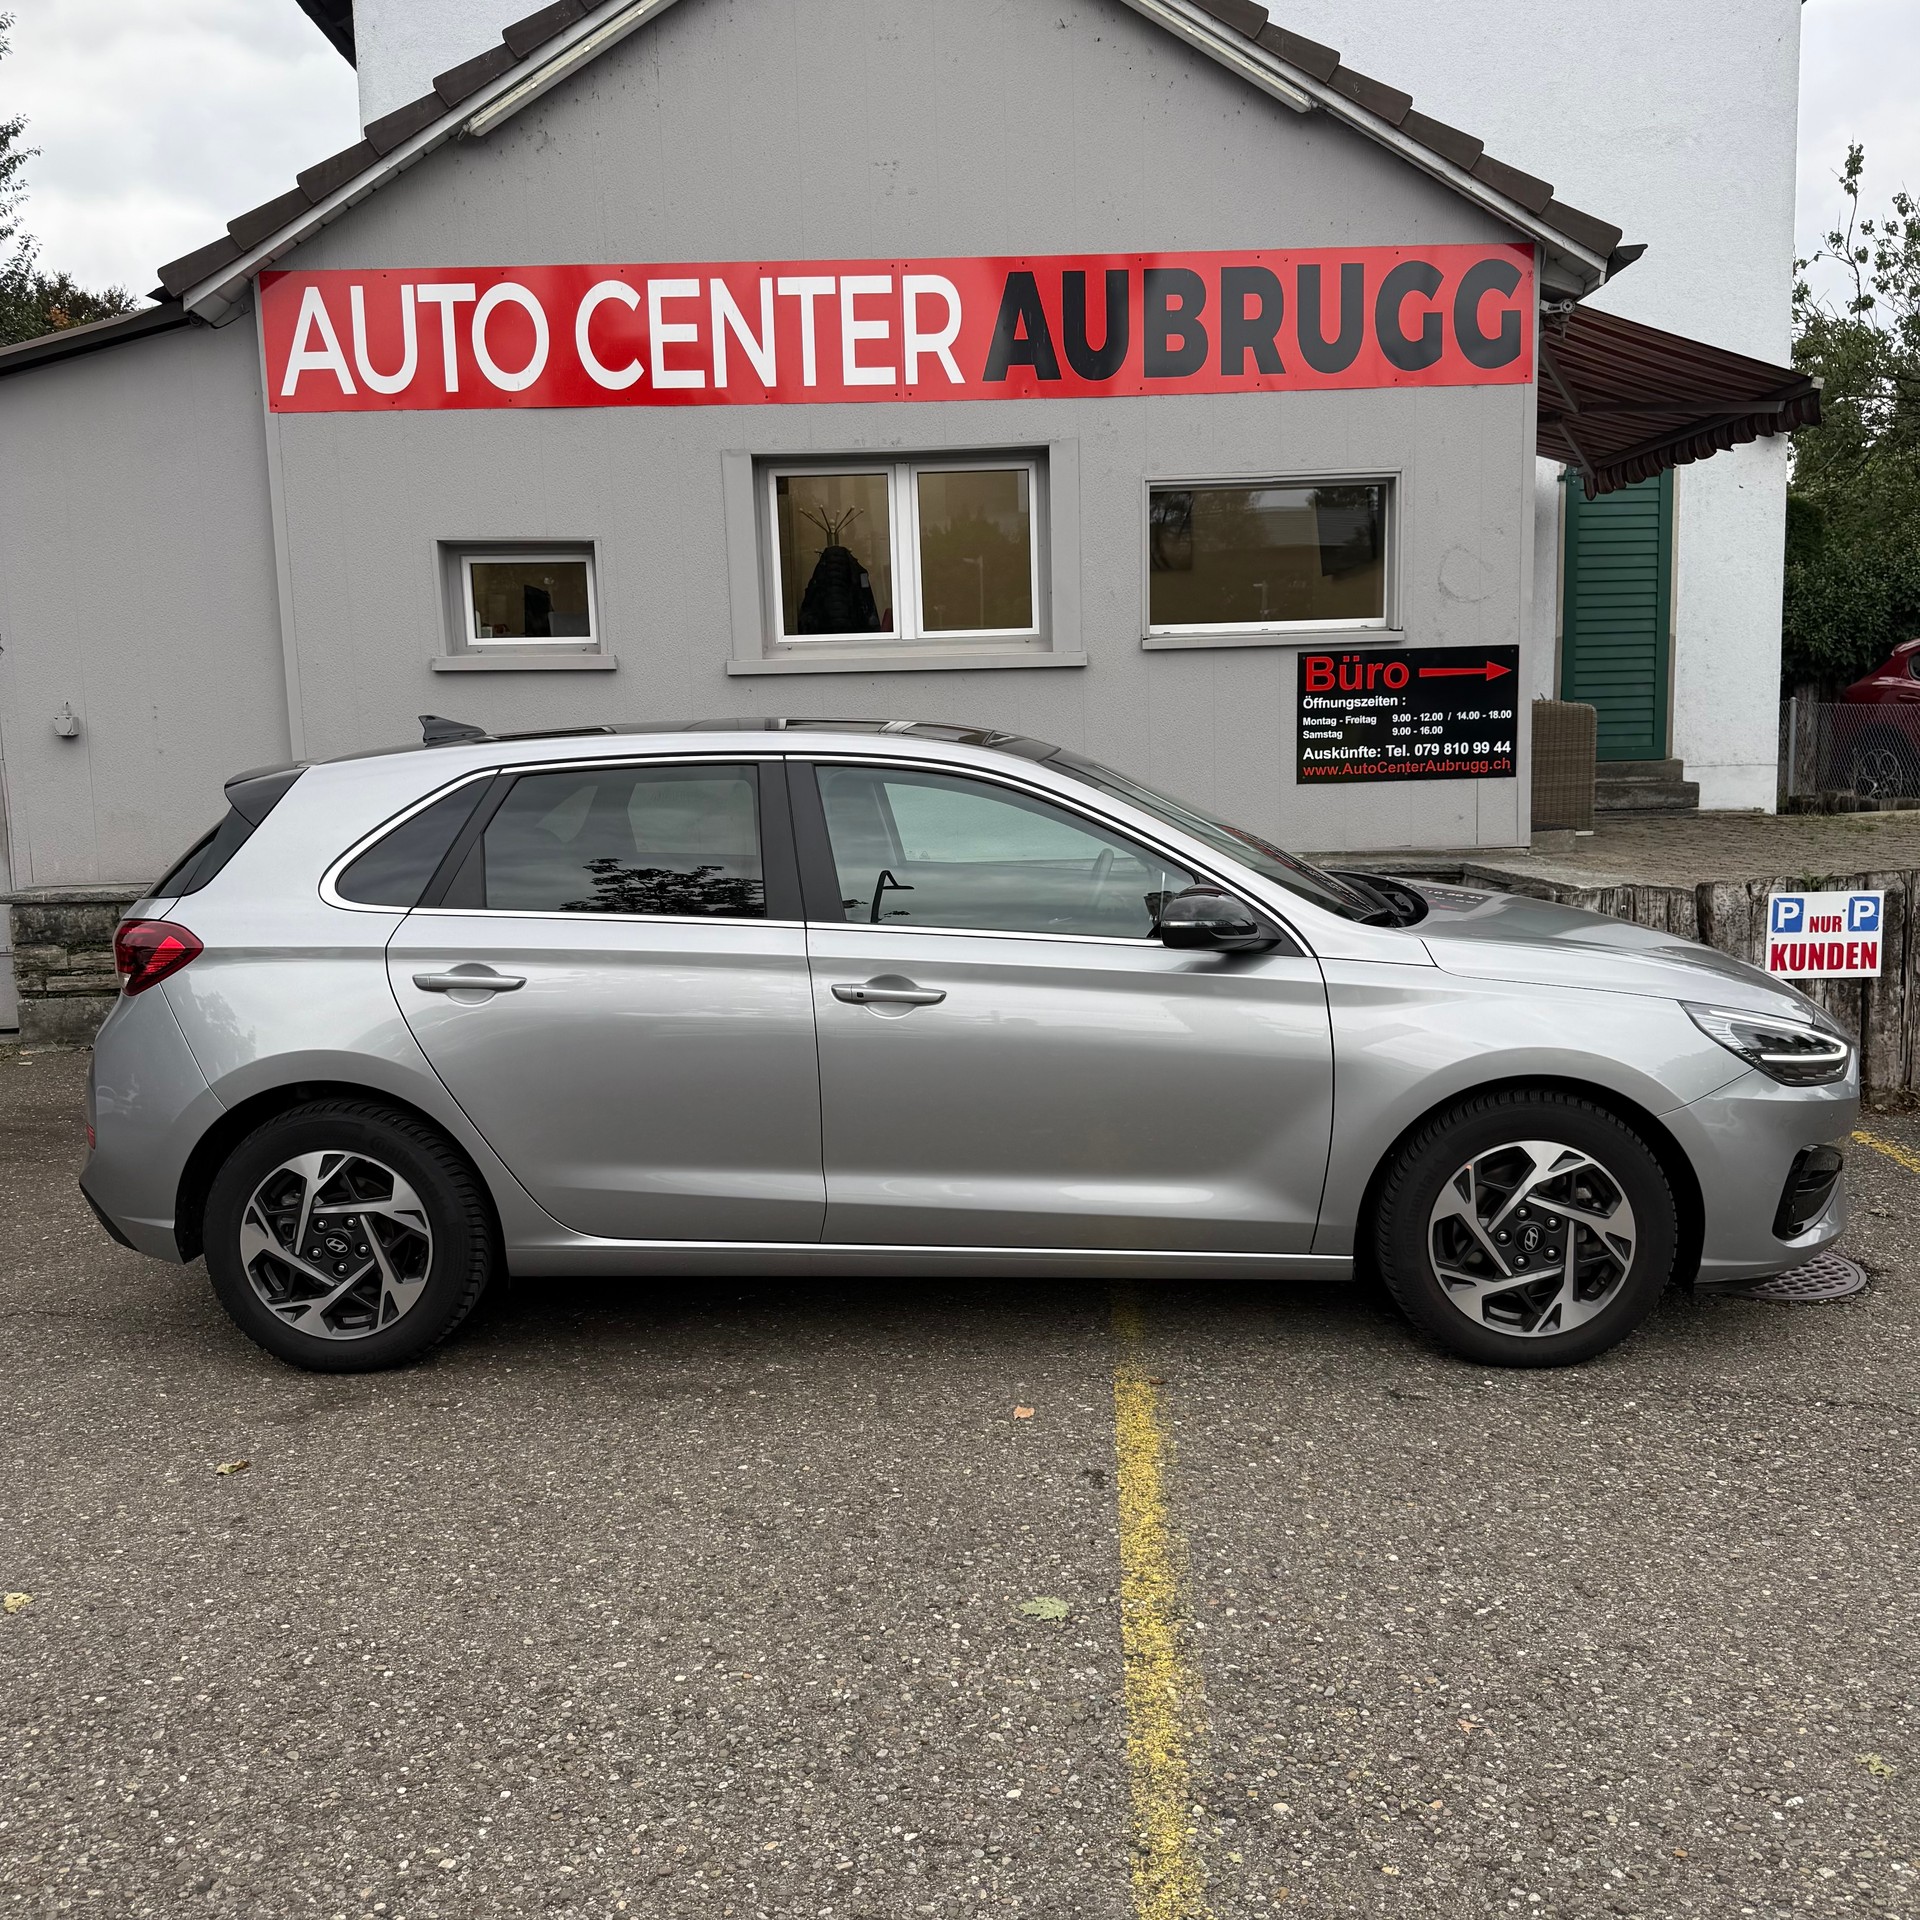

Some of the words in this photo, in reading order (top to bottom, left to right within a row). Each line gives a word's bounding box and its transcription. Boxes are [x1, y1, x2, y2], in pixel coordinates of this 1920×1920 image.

[280, 282, 551, 396] AUTO
[574, 273, 966, 391] CENTER
[982, 258, 1524, 382] AUBRUGG
[1305, 655, 1410, 692] Büro
[1302, 695, 1399, 711] Öffnungszeiten
[1302, 716, 1337, 727] Montag
[1345, 714, 1377, 726] Freitag
[1391, 713, 1412, 723] 9.00
[1419, 711, 1444, 722] 12.00
[1456, 710, 1481, 721] 14.00
[1488, 709, 1513, 720] 18.00
[1302, 730, 1343, 741] Samstag
[1391, 726, 1412, 736] 9.00
[1419, 725, 1444, 735] 16.00
[1302, 745, 1382, 761] Auskünfte:
[1385, 744, 1411, 758] Tel.
[1414, 742, 1440, 757] 079
[1443, 741, 1470, 756] 810
[1472, 741, 1491, 755] 99
[1493, 740, 1512, 754] 44
[1302, 757, 1511, 776] www.AutoCenterAubrugg.ch
[1777, 901, 1800, 929] P
[1809, 915, 1843, 933] NUR
[1853, 900, 1876, 927] P
[1770, 941, 1878, 972] KUNDEN
